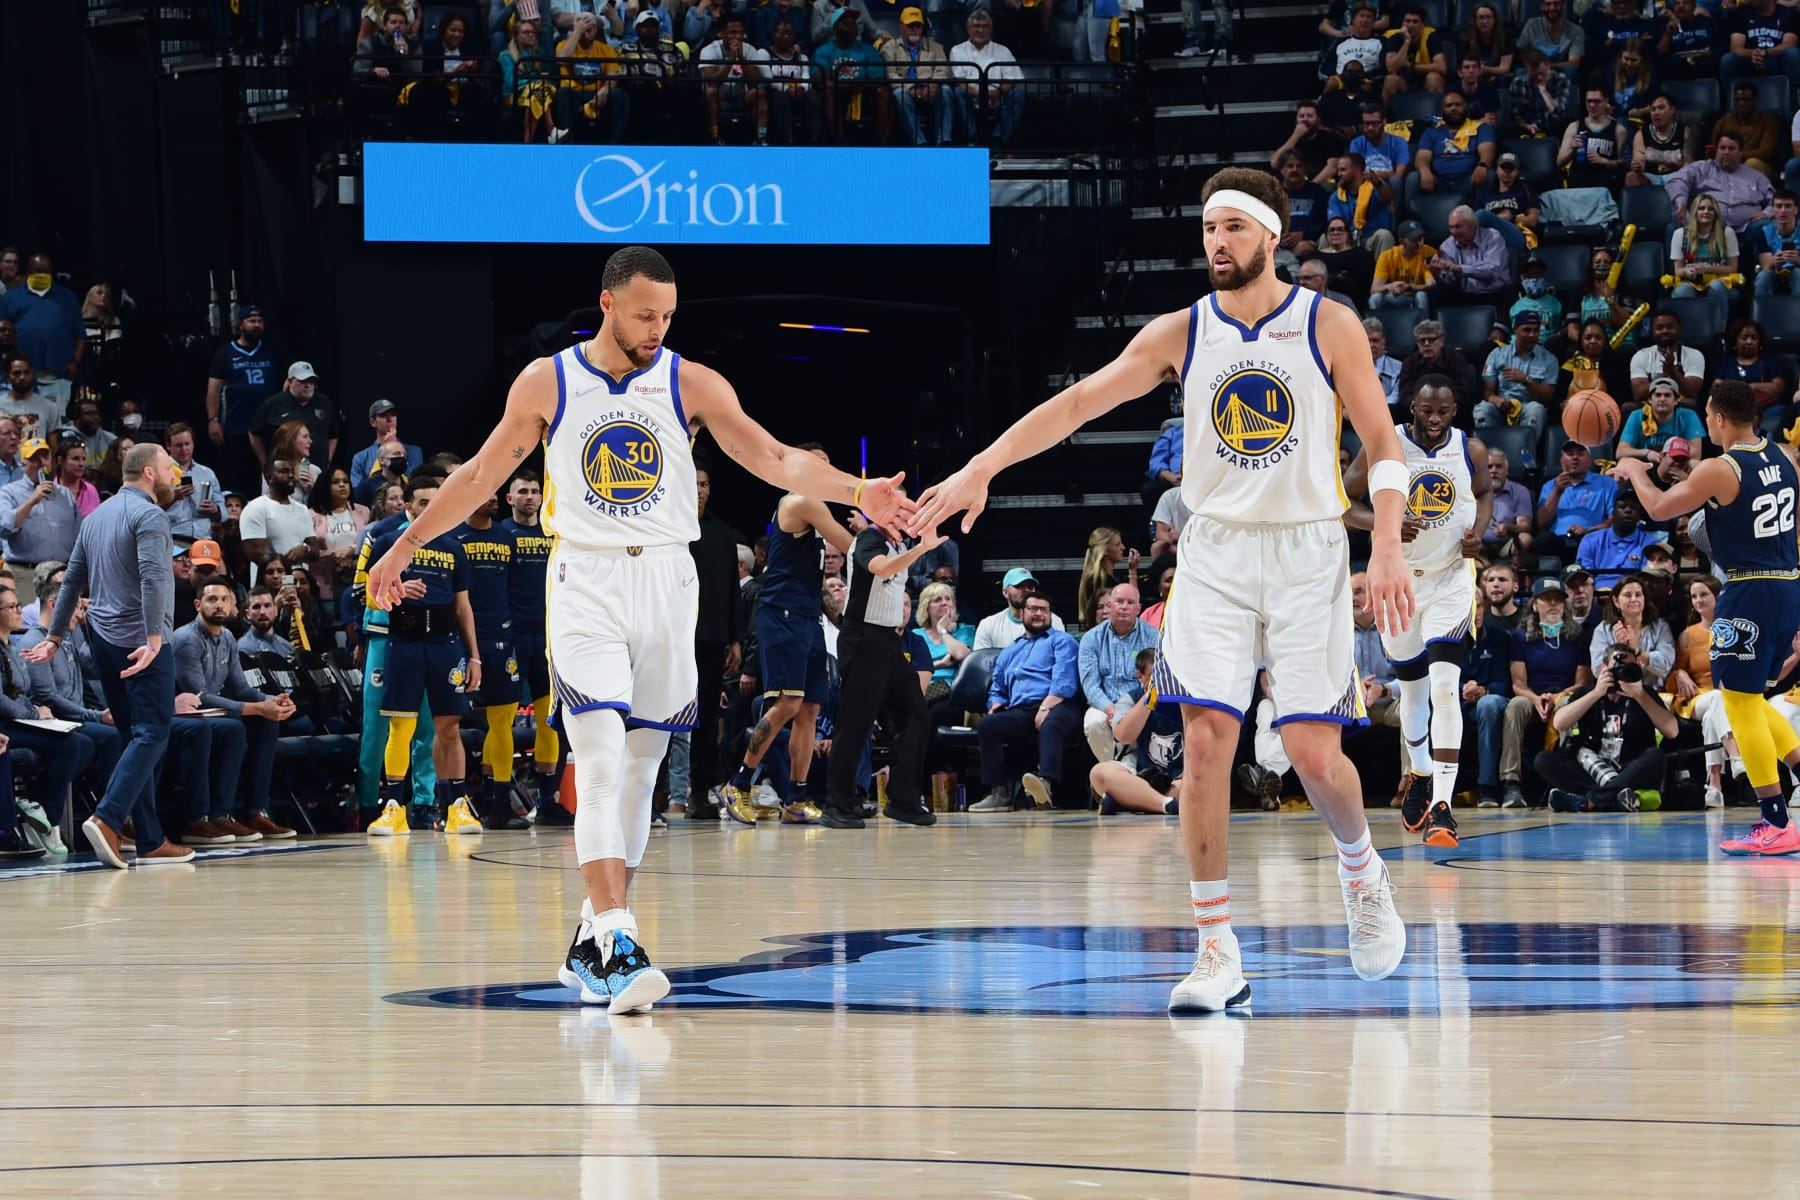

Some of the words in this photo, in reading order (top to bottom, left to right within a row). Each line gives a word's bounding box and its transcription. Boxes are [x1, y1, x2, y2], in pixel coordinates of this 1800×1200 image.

[574, 154, 791, 233] Orion
[1268, 330, 1302, 340] Rakuten
[245, 368, 265, 384] 12
[1209, 359, 1254, 391] GOLDEN
[1259, 360, 1293, 384] STATE
[634, 385, 667, 394] Rakuten
[1266, 389, 1277, 412] 11
[580, 410, 624, 440] GOLDEN
[629, 411, 661, 436] STATE
[625, 441, 655, 465] 30
[1215, 434, 1299, 470] WARRIORS
[1437, 466, 1456, 482] STATE
[583, 484, 666, 518] WARRIORS
[1432, 482, 1450, 498] 23
[1752, 486, 1795, 539] 22
